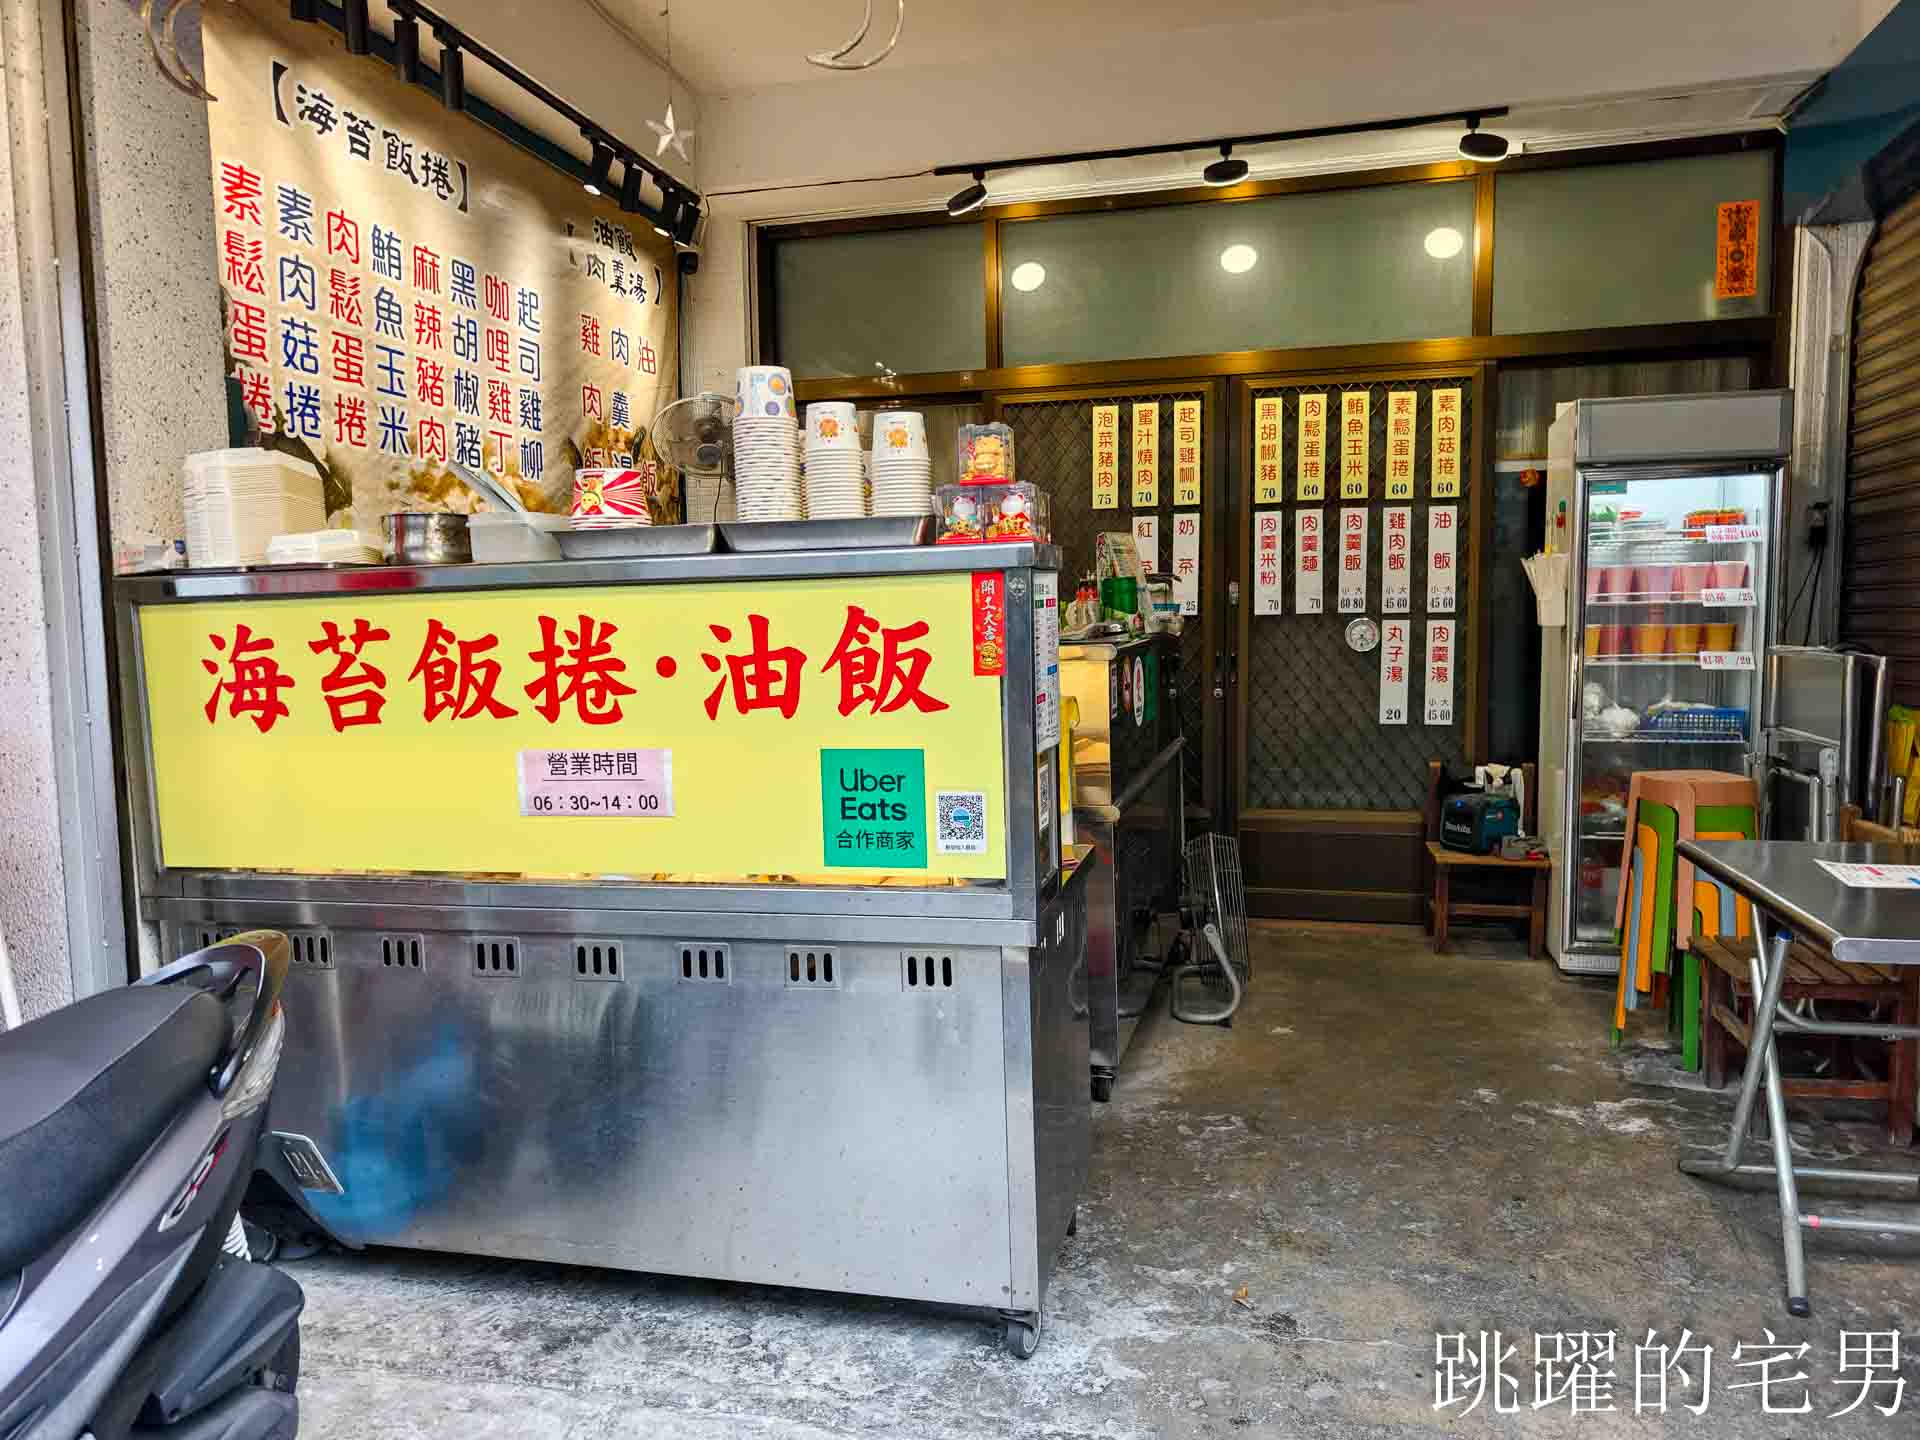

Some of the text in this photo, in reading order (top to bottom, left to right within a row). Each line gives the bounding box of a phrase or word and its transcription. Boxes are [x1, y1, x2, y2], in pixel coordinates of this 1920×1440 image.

[221, 162, 272, 430] 素鬆蛋捲
[277, 185, 320, 439] 素肉菇捲
[327, 210, 368, 447] 肉鬆蛋捲
[371, 224, 409, 456] 鮪魚玉米
[413, 245, 447, 462] 麻辣豬肉
[450, 260, 482, 468] 黑胡椒豬
[485, 272, 513, 475] 咖哩雞丁
[517, 288, 544, 481] 起司雞柳
[1098, 412, 1113, 488] 泡菜豬肉
[1137, 409, 1152, 486] 蜜汁燒肉
[1180, 408, 1194, 484] 起司雞柳
[1260, 404, 1276, 481] 黑胡椒豬
[1304, 400, 1320, 478] 肉鬆蛋捲
[1347, 399, 1364, 478] 鮪魚玉米
[1439, 395, 1456, 476] 素肉菇捲
[1098, 494, 1112, 505] 75
[1138, 492, 1152, 502] 70
[1181, 490, 1194, 501] 70
[1263, 488, 1275, 498] 70
[1304, 484, 1318, 496] 60
[1347, 483, 1362, 494] 60
[1392, 483, 1407, 495] 60
[1437, 482, 1452, 494] 60
[1389, 513, 1406, 570] 雞肉飯
[981, 579, 998, 640] 開工大吉
[1186, 602, 1196, 611] 25
[1268, 600, 1279, 610] 70
[1310, 598, 1320, 608] 70
[1385, 625, 1404, 682] 丸子湯
[1386, 709, 1401, 720] 20
[547, 752, 638, 776] 營業時間
[839, 768, 906, 792] Uber
[841, 796, 907, 821] Eats
[836, 830, 915, 850] 合作商家
